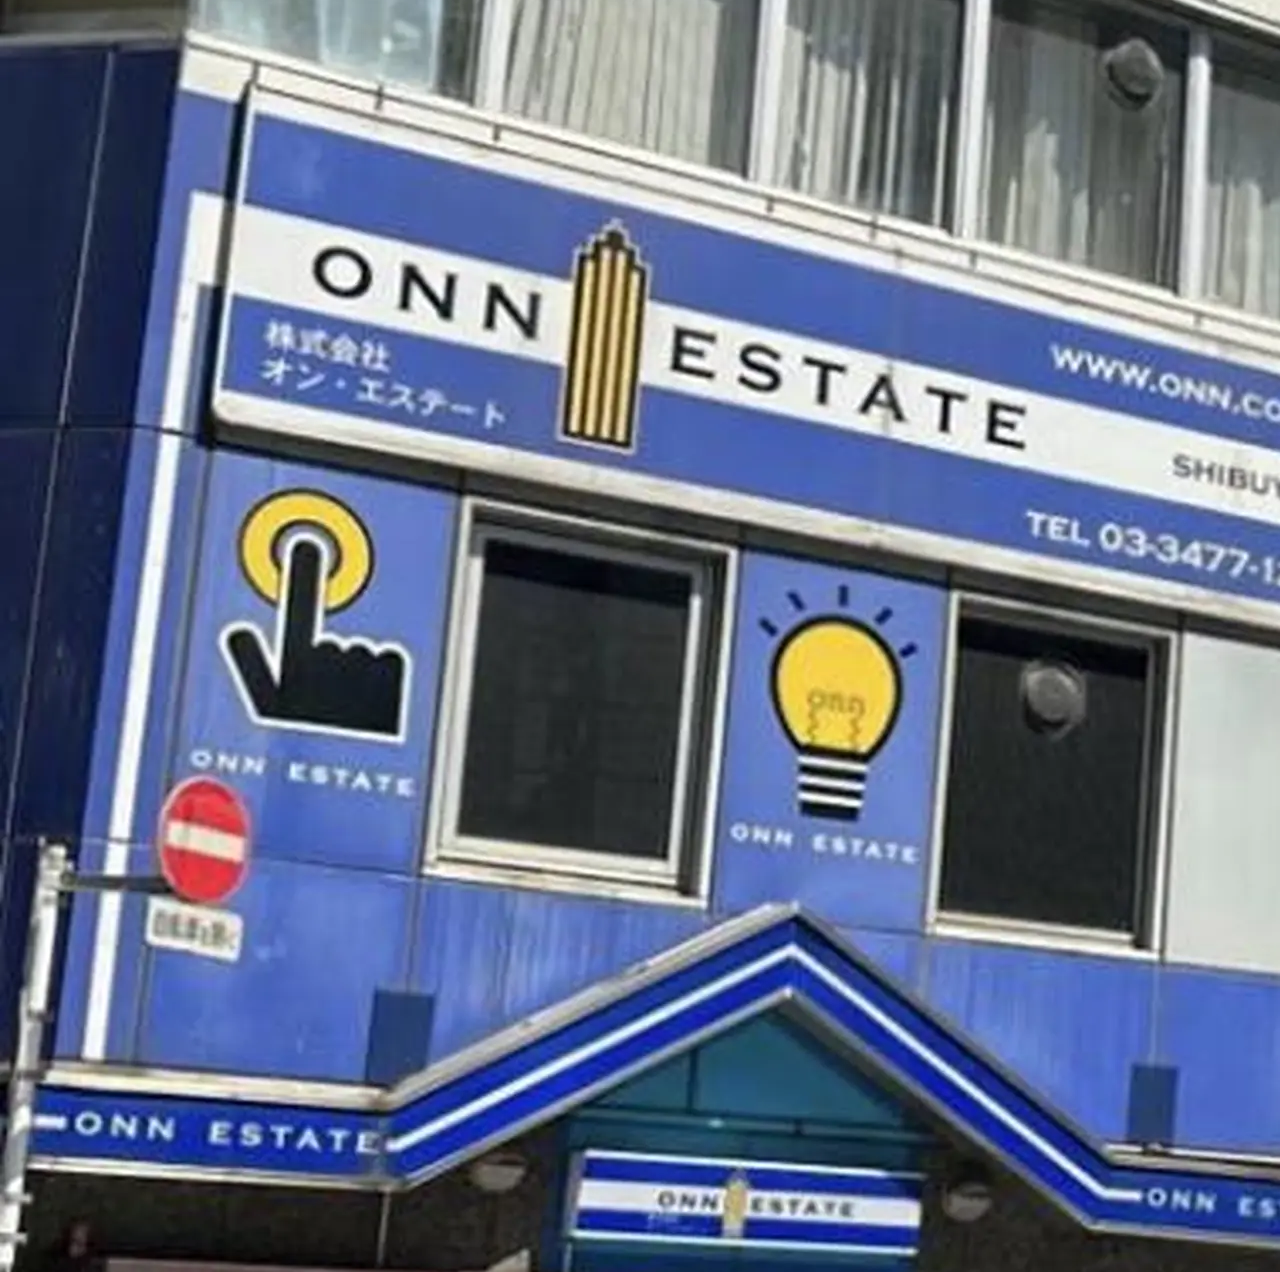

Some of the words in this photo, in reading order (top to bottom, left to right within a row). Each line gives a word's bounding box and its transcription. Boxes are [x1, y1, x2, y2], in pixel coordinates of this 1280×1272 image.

[262, 320, 392, 375] 株式会社
[312, 245, 542, 342] ONN
[669, 327, 1029, 452] ESTATE
[259, 354, 506, 431] オン・エステート
[1026, 511, 1091, 546] TEL
[189, 748, 267, 776] ONN
[287, 761, 417, 798] ESTATE
[729, 822, 794, 848] ONN
[811, 832, 920, 864] ESTATE
[73, 1109, 176, 1140] ONN
[208, 1122, 380, 1154] ESTATE
[657, 1189, 719, 1211] ONN
[750, 1196, 855, 1218] ESTATE
[1146, 1186, 1217, 1214] ONN
